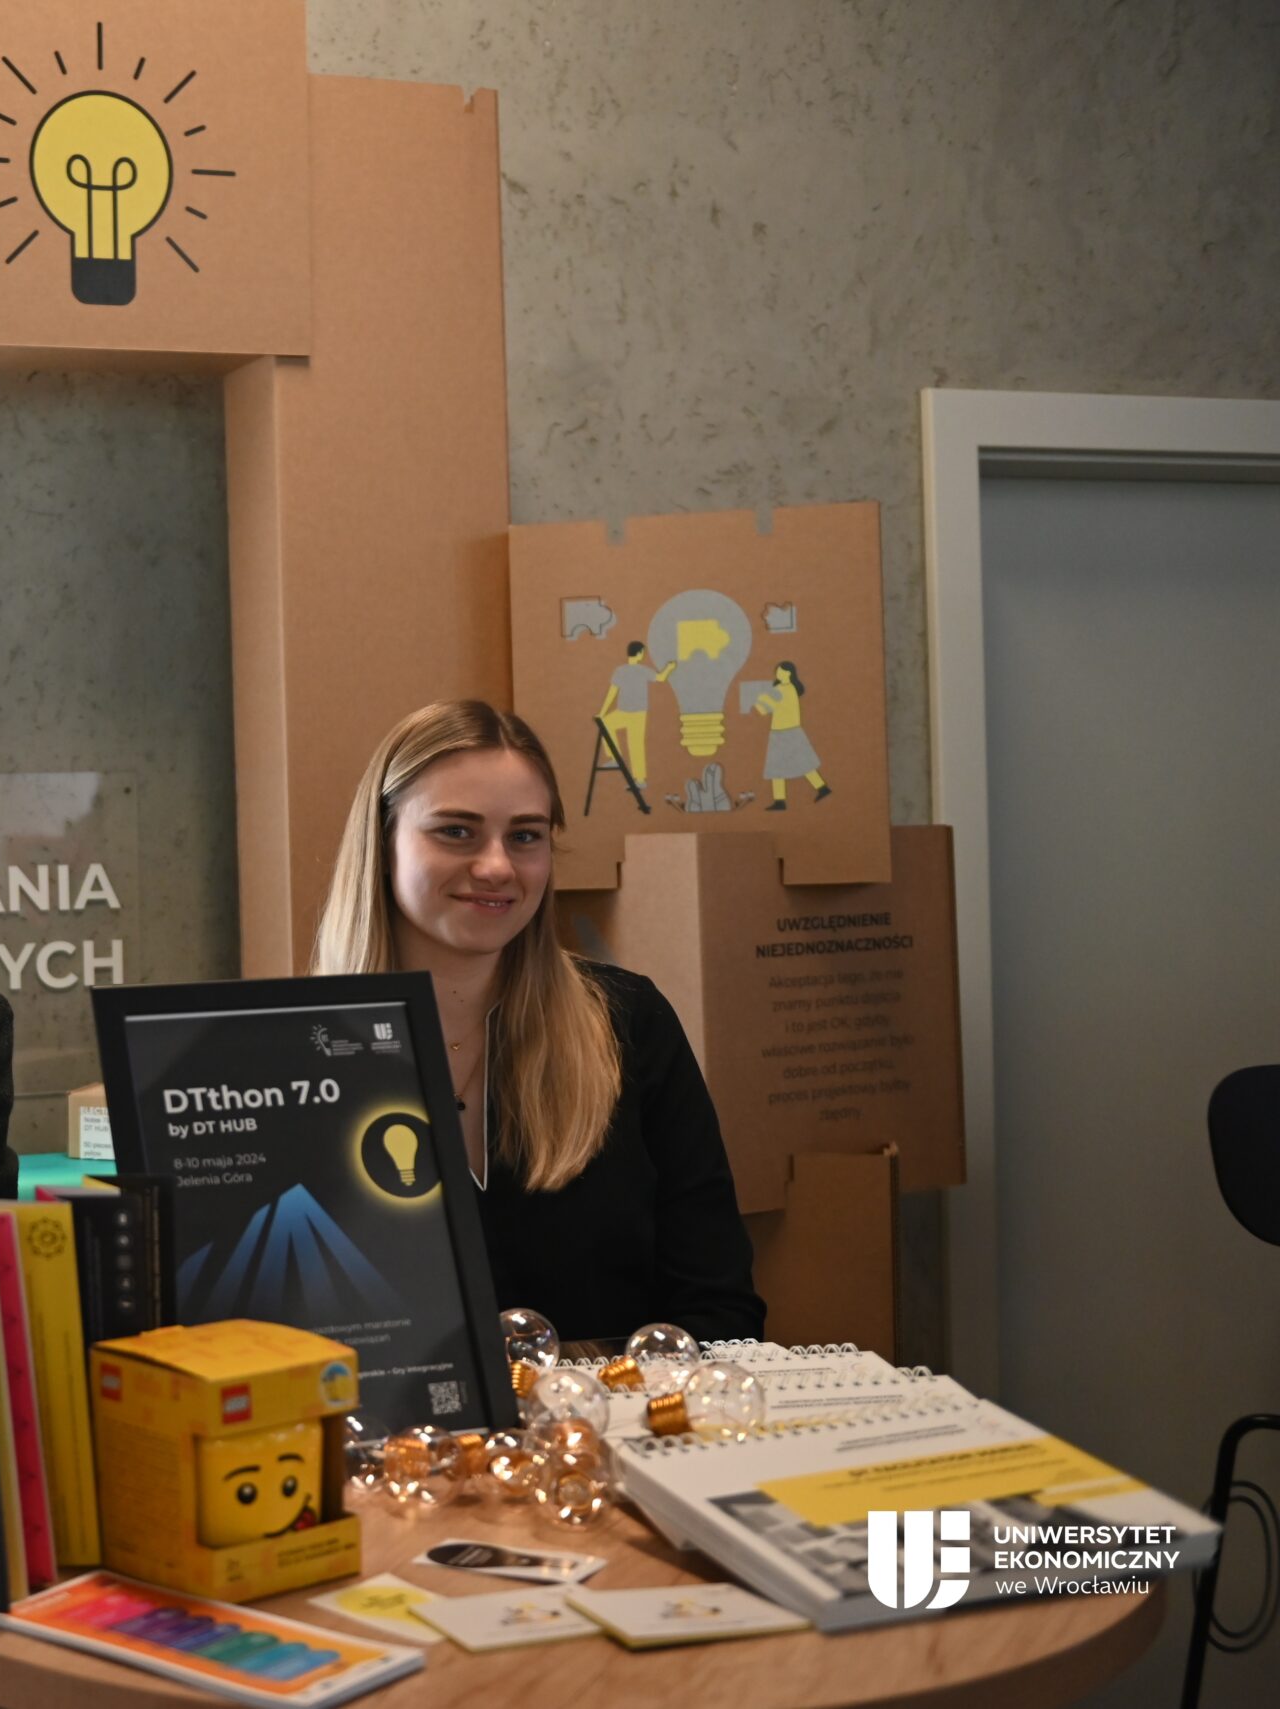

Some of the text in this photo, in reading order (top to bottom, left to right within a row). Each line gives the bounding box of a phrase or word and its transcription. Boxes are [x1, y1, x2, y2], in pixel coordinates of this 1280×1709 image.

[776, 911, 892, 933] UWZGLĘDNIENIE
[755, 933, 914, 959] NIEJEDNOZNACZNOŚCI
[163, 1077, 341, 1115] DTthon 7.0
[168, 1117, 258, 1140] by DT HUB
[173, 1152, 267, 1171] 8-10 maja 2024
[176, 1171, 253, 1188] Jelenia Góra
